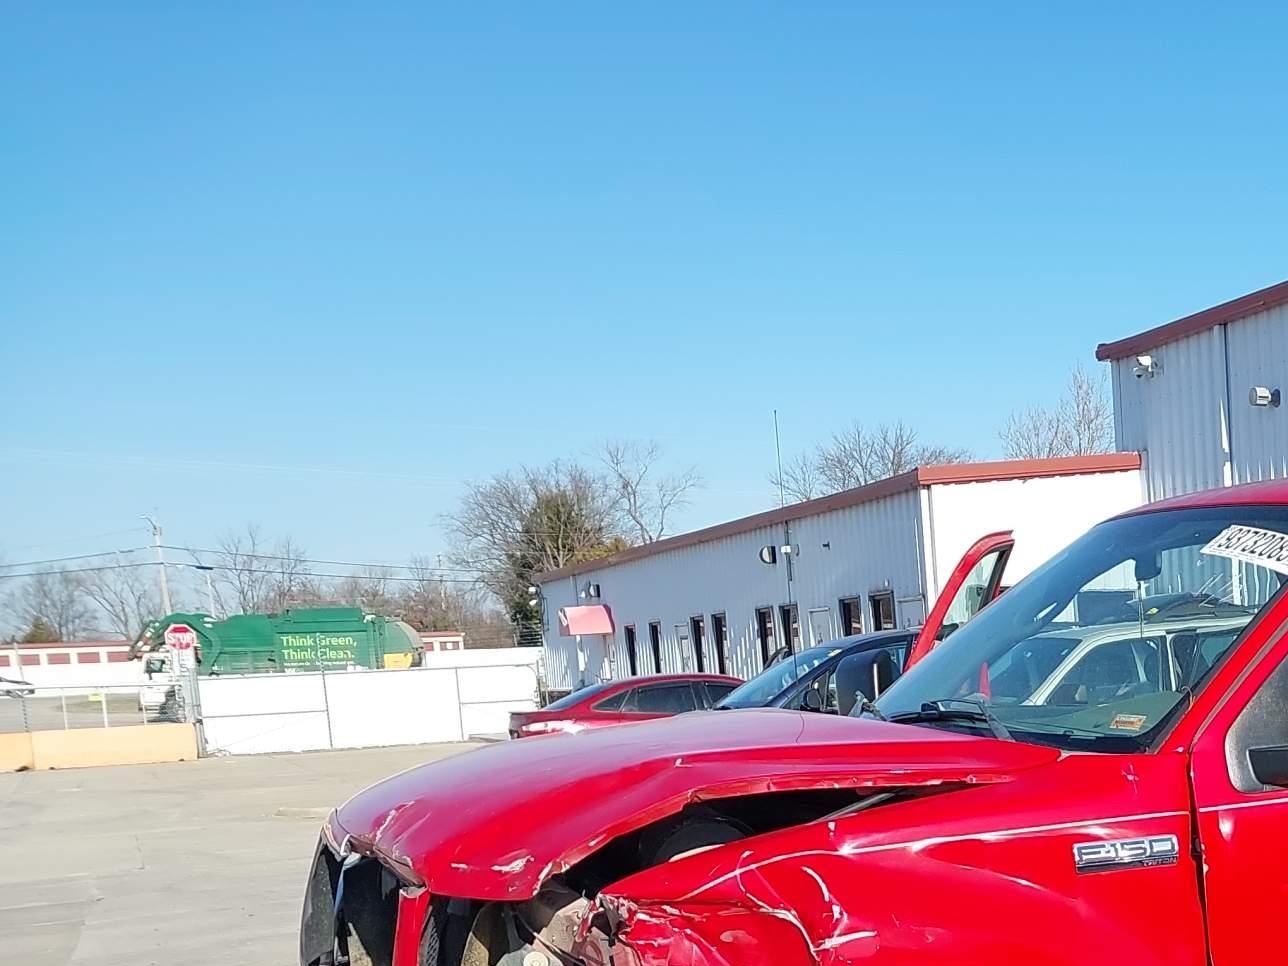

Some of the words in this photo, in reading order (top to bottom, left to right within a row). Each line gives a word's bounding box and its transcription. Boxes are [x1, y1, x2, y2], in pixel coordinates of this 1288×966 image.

[166, 631, 194, 645] STOP
[281, 635, 314, 647] Think
[318, 636, 357, 647] Green,
[281, 649, 316, 660] Think
[318, 648, 355, 660] Clean.
